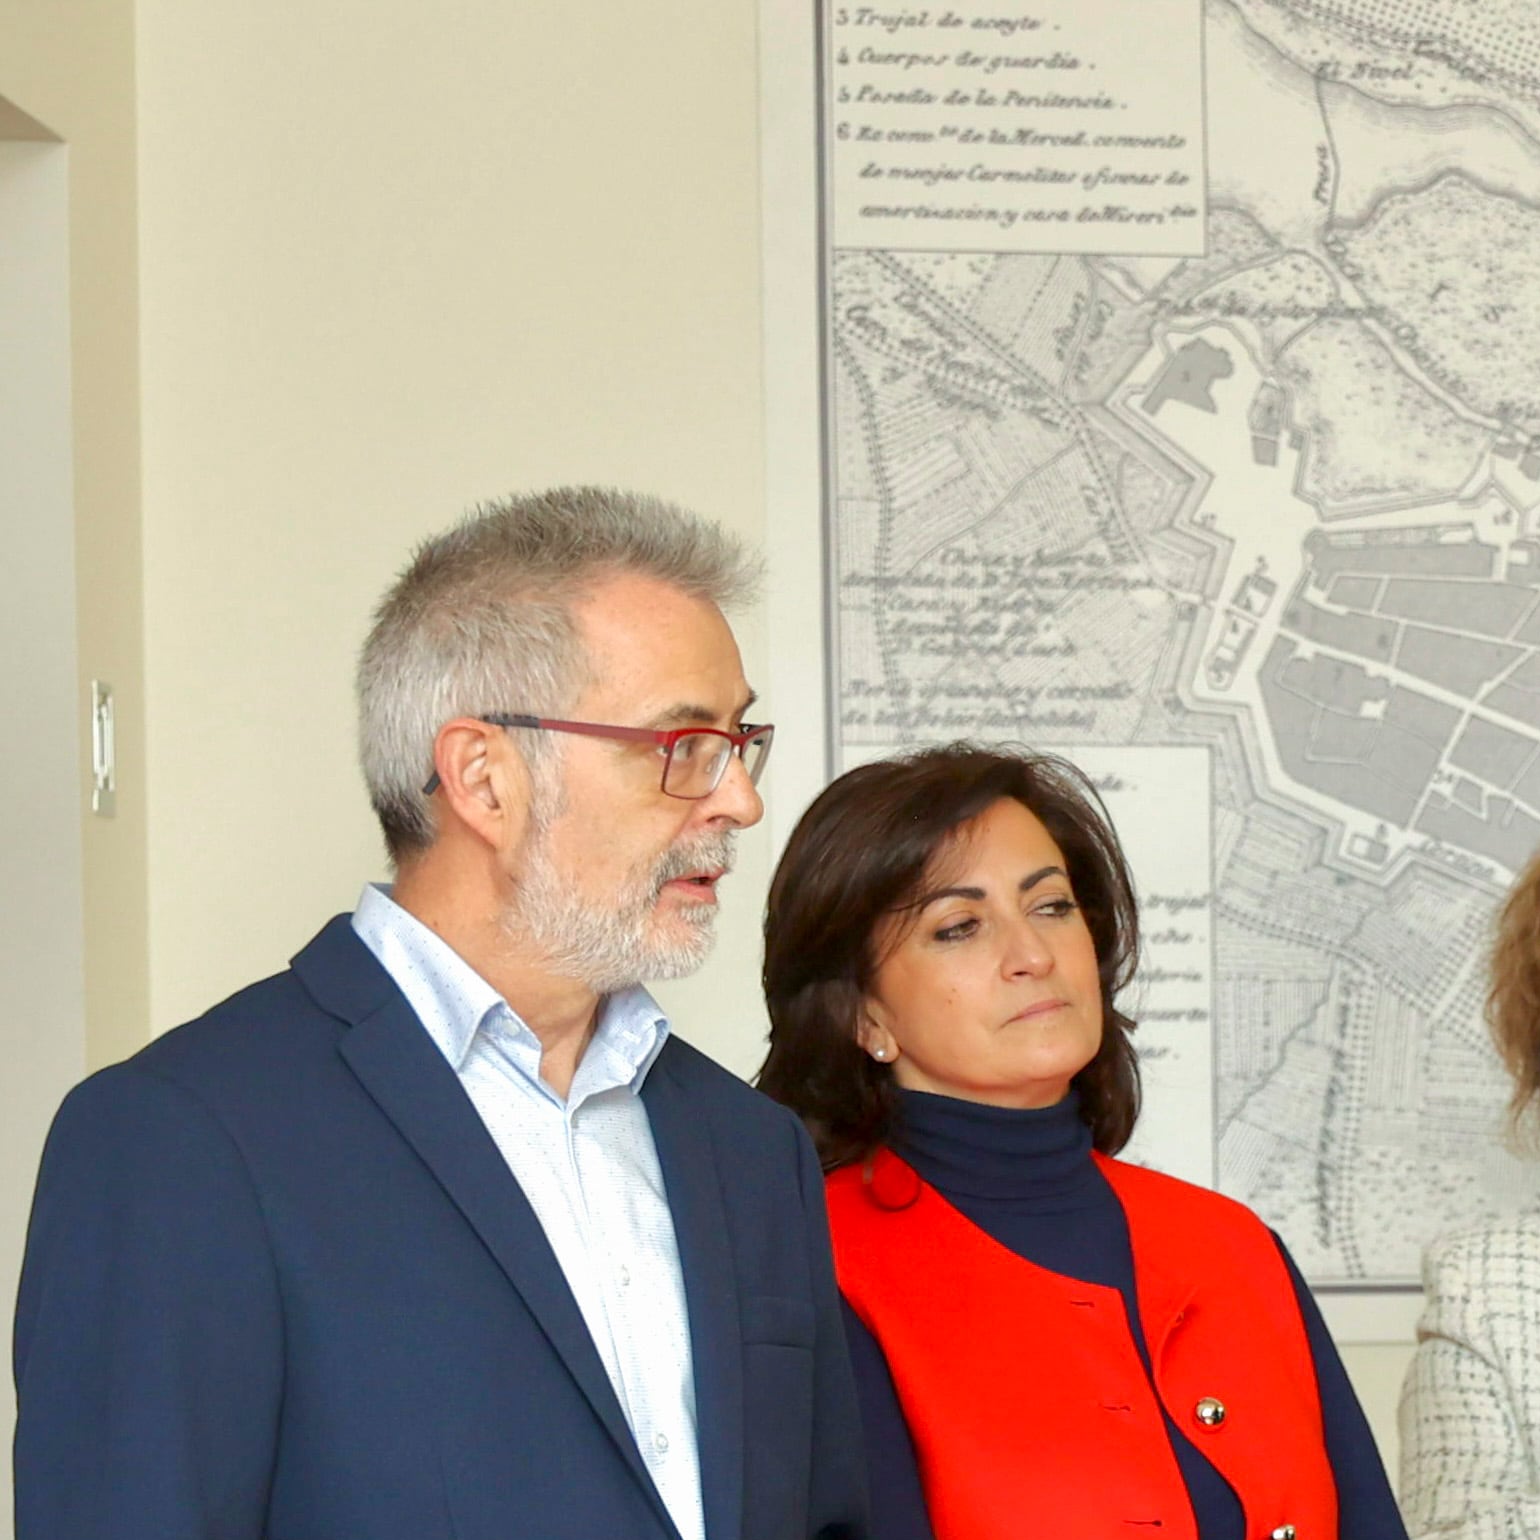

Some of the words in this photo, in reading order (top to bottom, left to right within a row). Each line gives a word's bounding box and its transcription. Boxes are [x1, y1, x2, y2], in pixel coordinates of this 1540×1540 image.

[937, 12, 963, 28] de
[955, 51, 985, 67] de
[944, 89, 971, 105] de
[975, 88, 998, 106] la
[957, 128, 984, 144] de
[859, 162, 884, 178] de
[1165, 169, 1190, 186] de
